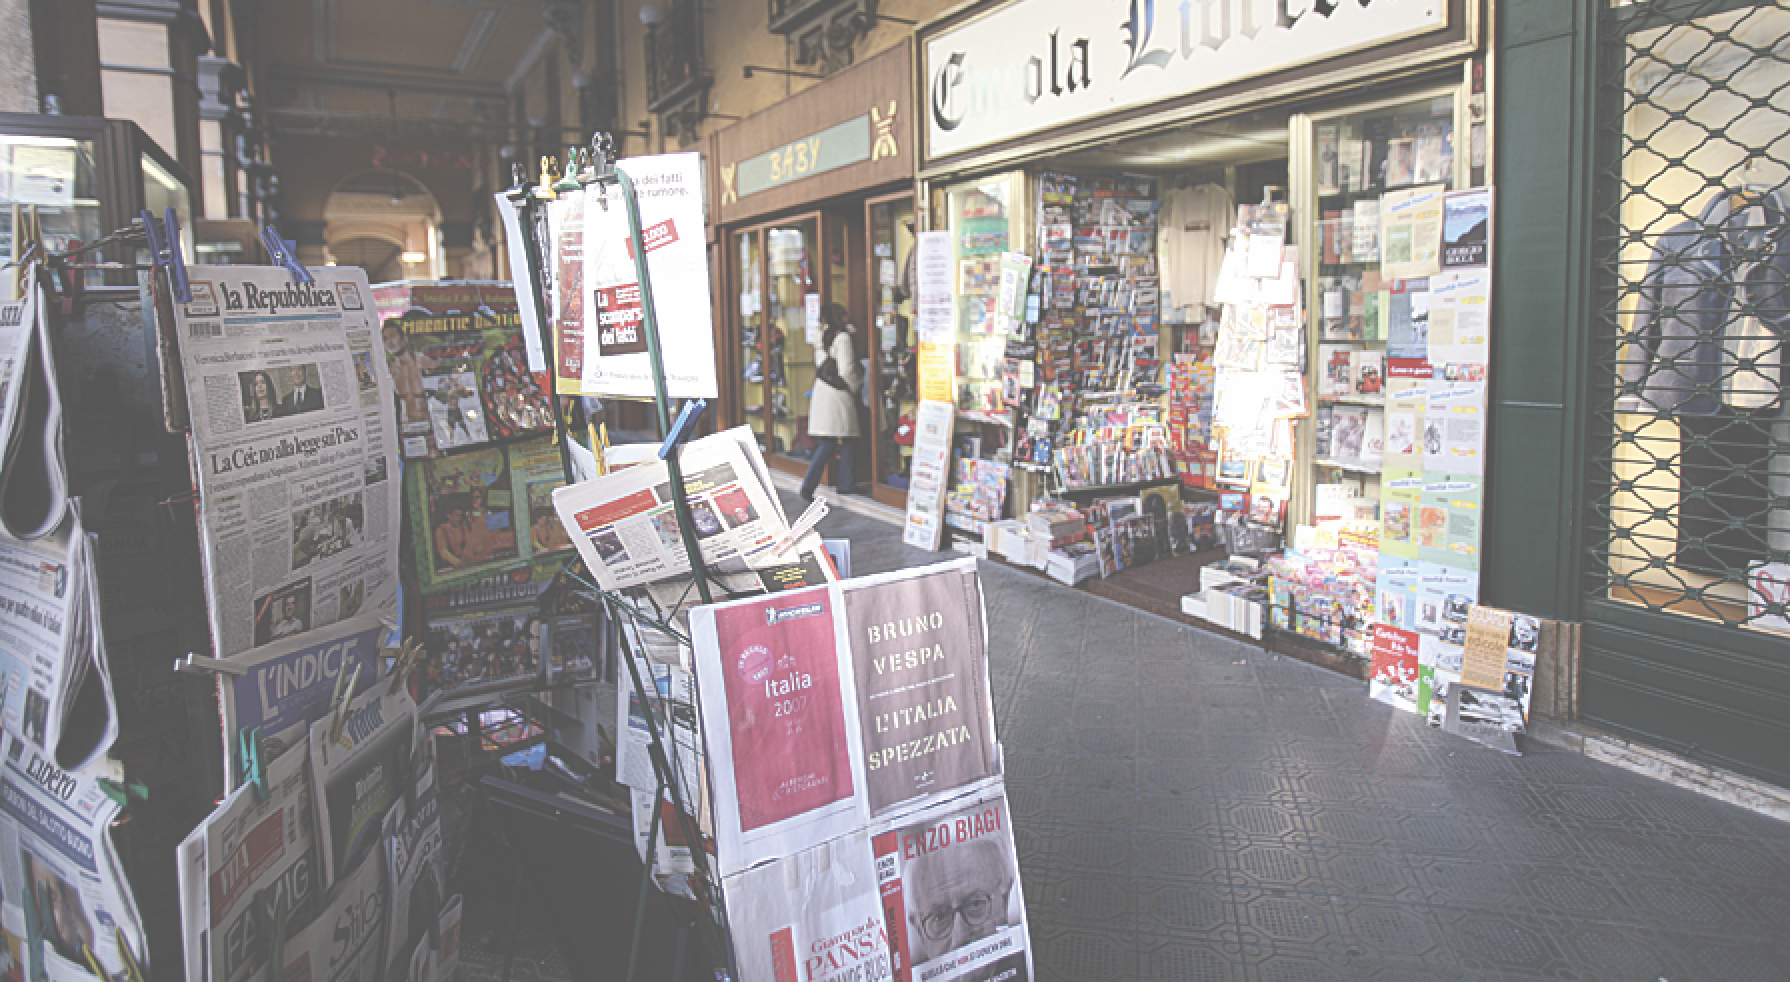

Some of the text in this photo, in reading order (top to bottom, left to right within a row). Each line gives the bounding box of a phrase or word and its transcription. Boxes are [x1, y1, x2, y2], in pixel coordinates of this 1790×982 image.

[769, 137, 821, 181] BABY
[220, 281, 337, 314] la Repubblica
[211, 453, 232, 475] La
[232, 446, 258, 469] Cei:
[259, 446, 275, 464] no
[867, 611, 944, 644] BRUNO
[873, 643, 945, 675] VESPA
[258, 639, 359, 721] L'INDICE
[765, 671, 812, 698] Italia
[774, 696, 808, 718] 2007
[875, 695, 959, 733] L'ITALIA
[869, 725, 972, 771] SPEZZATA
[26, 753, 78, 801] Libero
[902, 806, 1002, 861] ENZO BIAGI
[804, 927, 889, 982] PANSA
